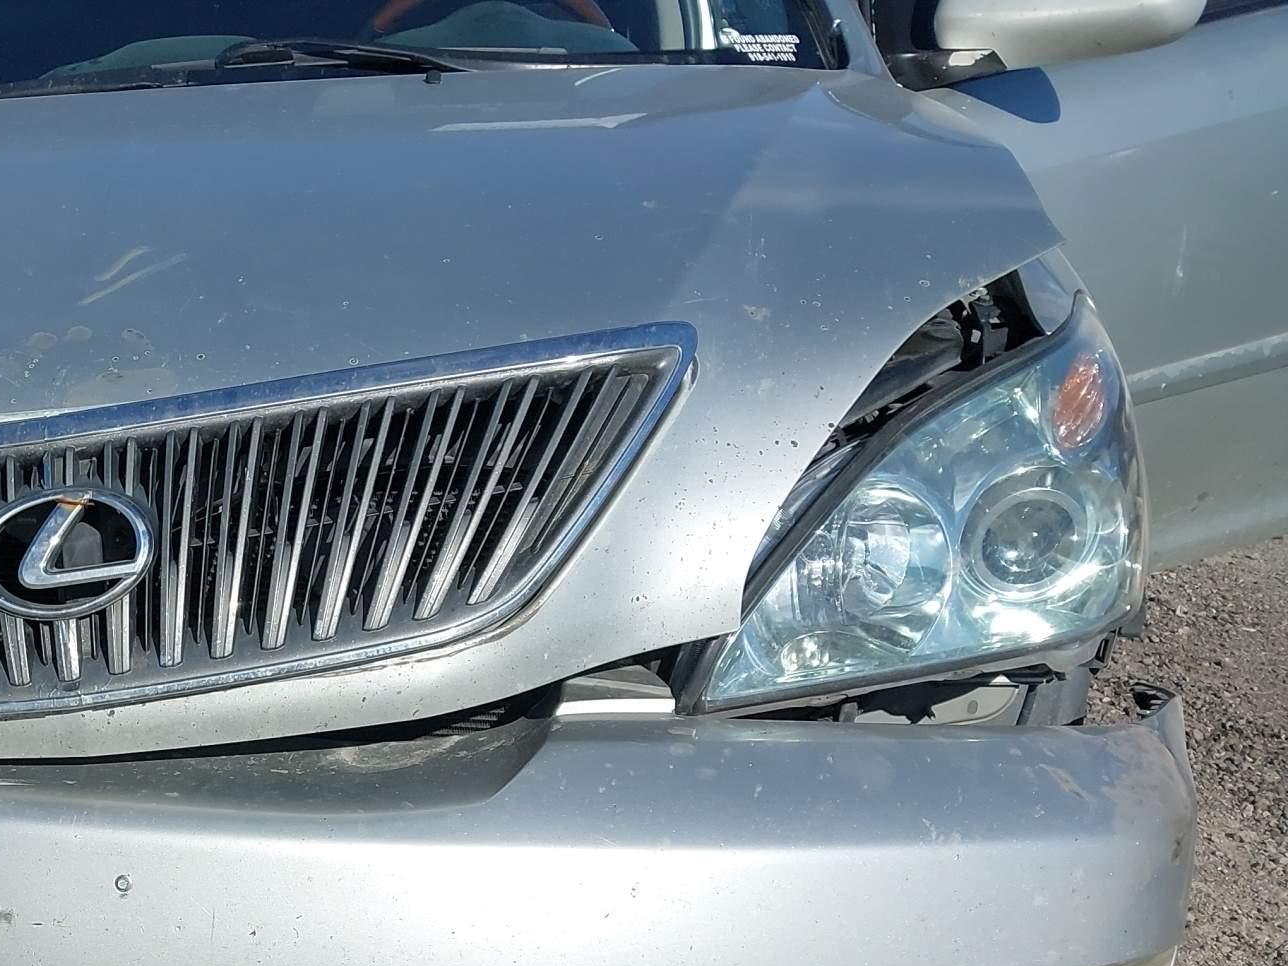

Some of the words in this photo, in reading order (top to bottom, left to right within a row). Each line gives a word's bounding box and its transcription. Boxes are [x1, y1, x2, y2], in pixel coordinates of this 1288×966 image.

[755, 34, 800, 44] ABANDONED
[733, 43, 764, 53] PLEASE
[763, 43, 797, 53] CONTACT
